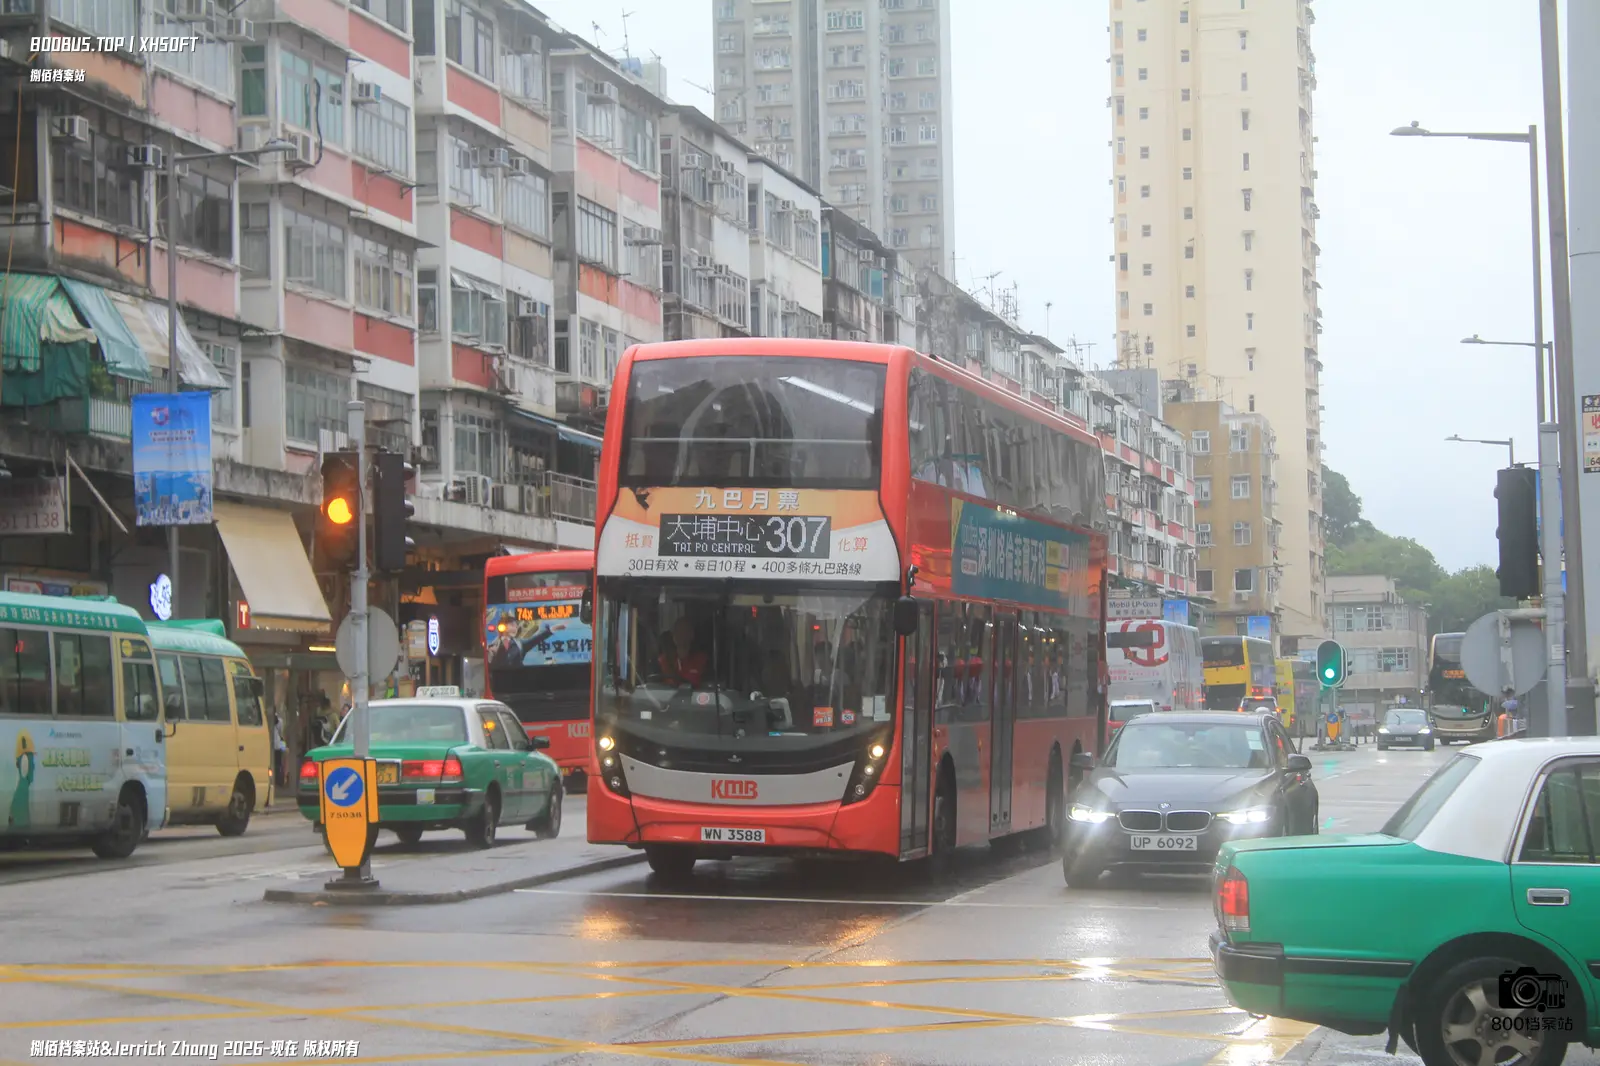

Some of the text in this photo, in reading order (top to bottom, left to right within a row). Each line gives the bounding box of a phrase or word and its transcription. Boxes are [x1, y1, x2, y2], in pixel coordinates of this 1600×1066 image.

[695, 489, 800, 511] 九巴月票
[667, 515, 765, 541] 大埔中心
[766, 516, 828, 553] 307
[625, 533, 653, 548] 抵買
[673, 542, 757, 554] TAI PO CENTRAL
[838, 536, 868, 553] 化算
[628, 559, 862, 576] 30日有效 每日10程 400多條九巴路線
[21, 608, 41, 621] SEATS
[420, 687, 456, 696] TAXI
[711, 779, 758, 799] KMB
[704, 828, 762, 842] WN 3588
[1133, 837, 1194, 849] UP 6092
